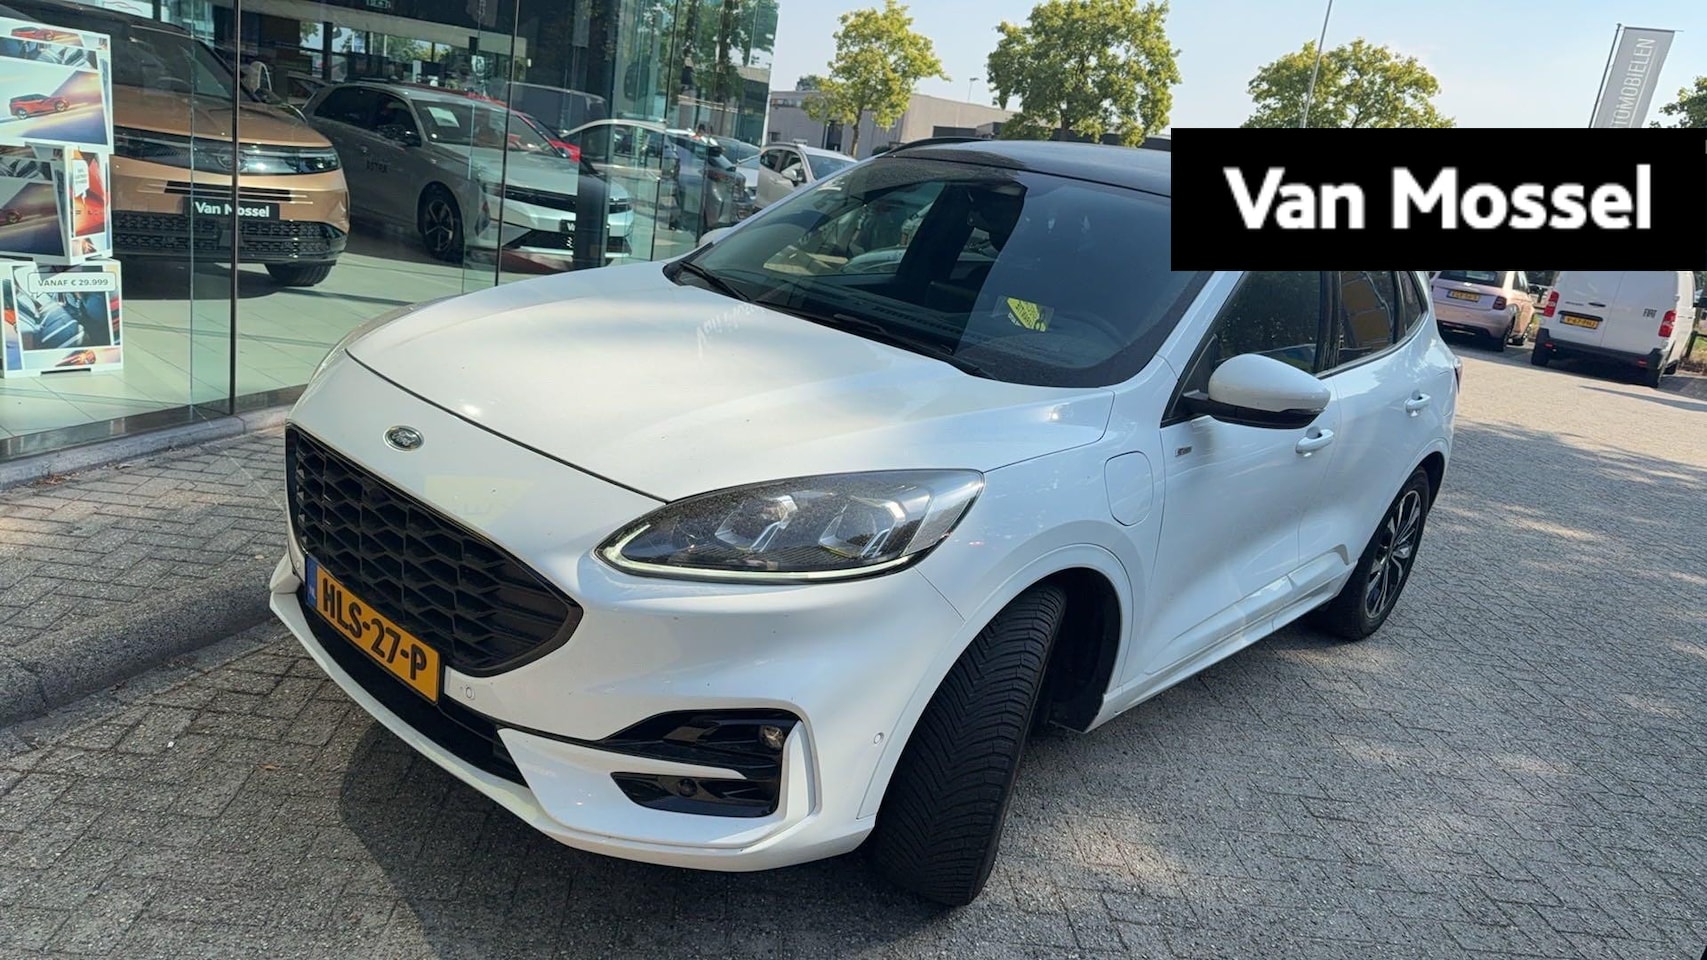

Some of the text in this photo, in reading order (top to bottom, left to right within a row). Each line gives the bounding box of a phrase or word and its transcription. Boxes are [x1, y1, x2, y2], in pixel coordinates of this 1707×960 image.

[1609, 38, 1656, 128] TOMOBIELEN
[195, 201, 221, 215] Van
[38, 279, 67, 287] VANAF
[322, 577, 428, 681] HLS-27-P
